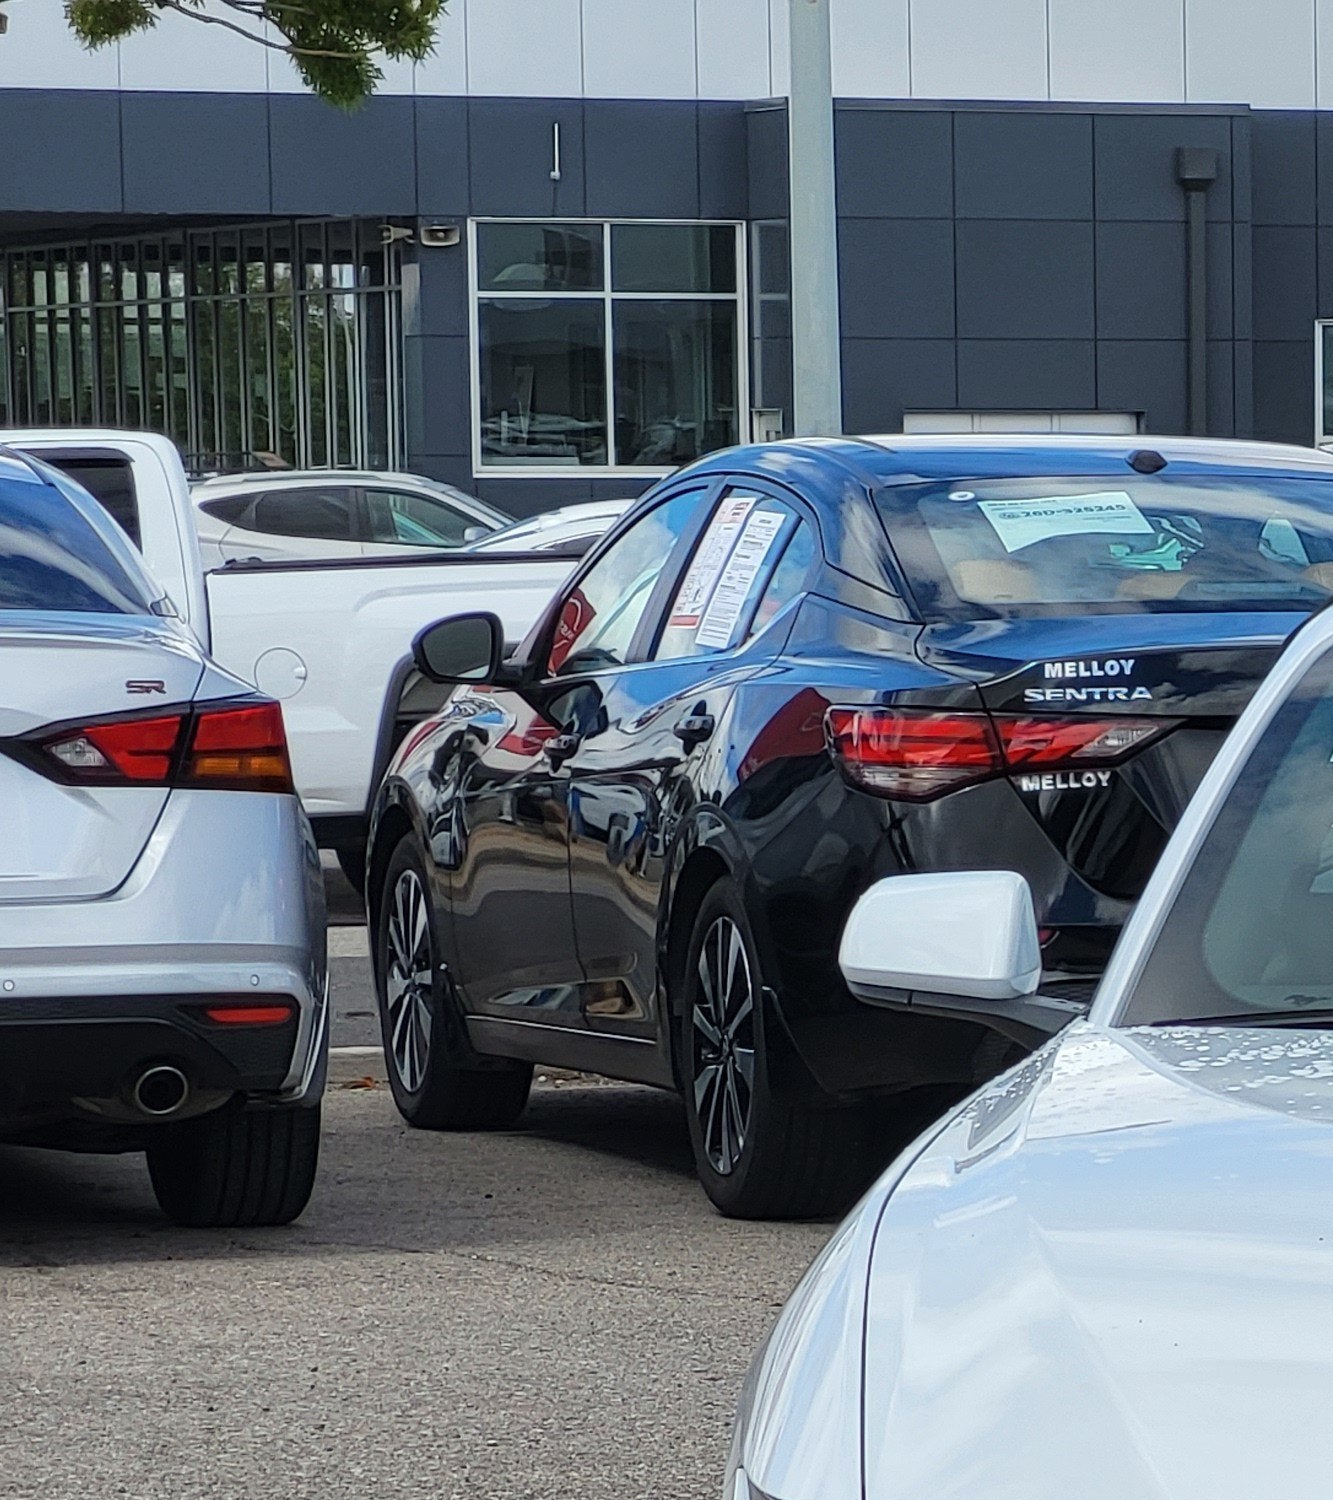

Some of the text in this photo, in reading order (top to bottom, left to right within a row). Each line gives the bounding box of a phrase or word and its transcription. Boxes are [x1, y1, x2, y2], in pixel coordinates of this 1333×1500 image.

[1044, 659, 1135, 679] MELLOY
[126, 680, 167, 694] SR
[1024, 687, 1153, 702] SENTRA
[1021, 771, 1112, 792] MELLOY
